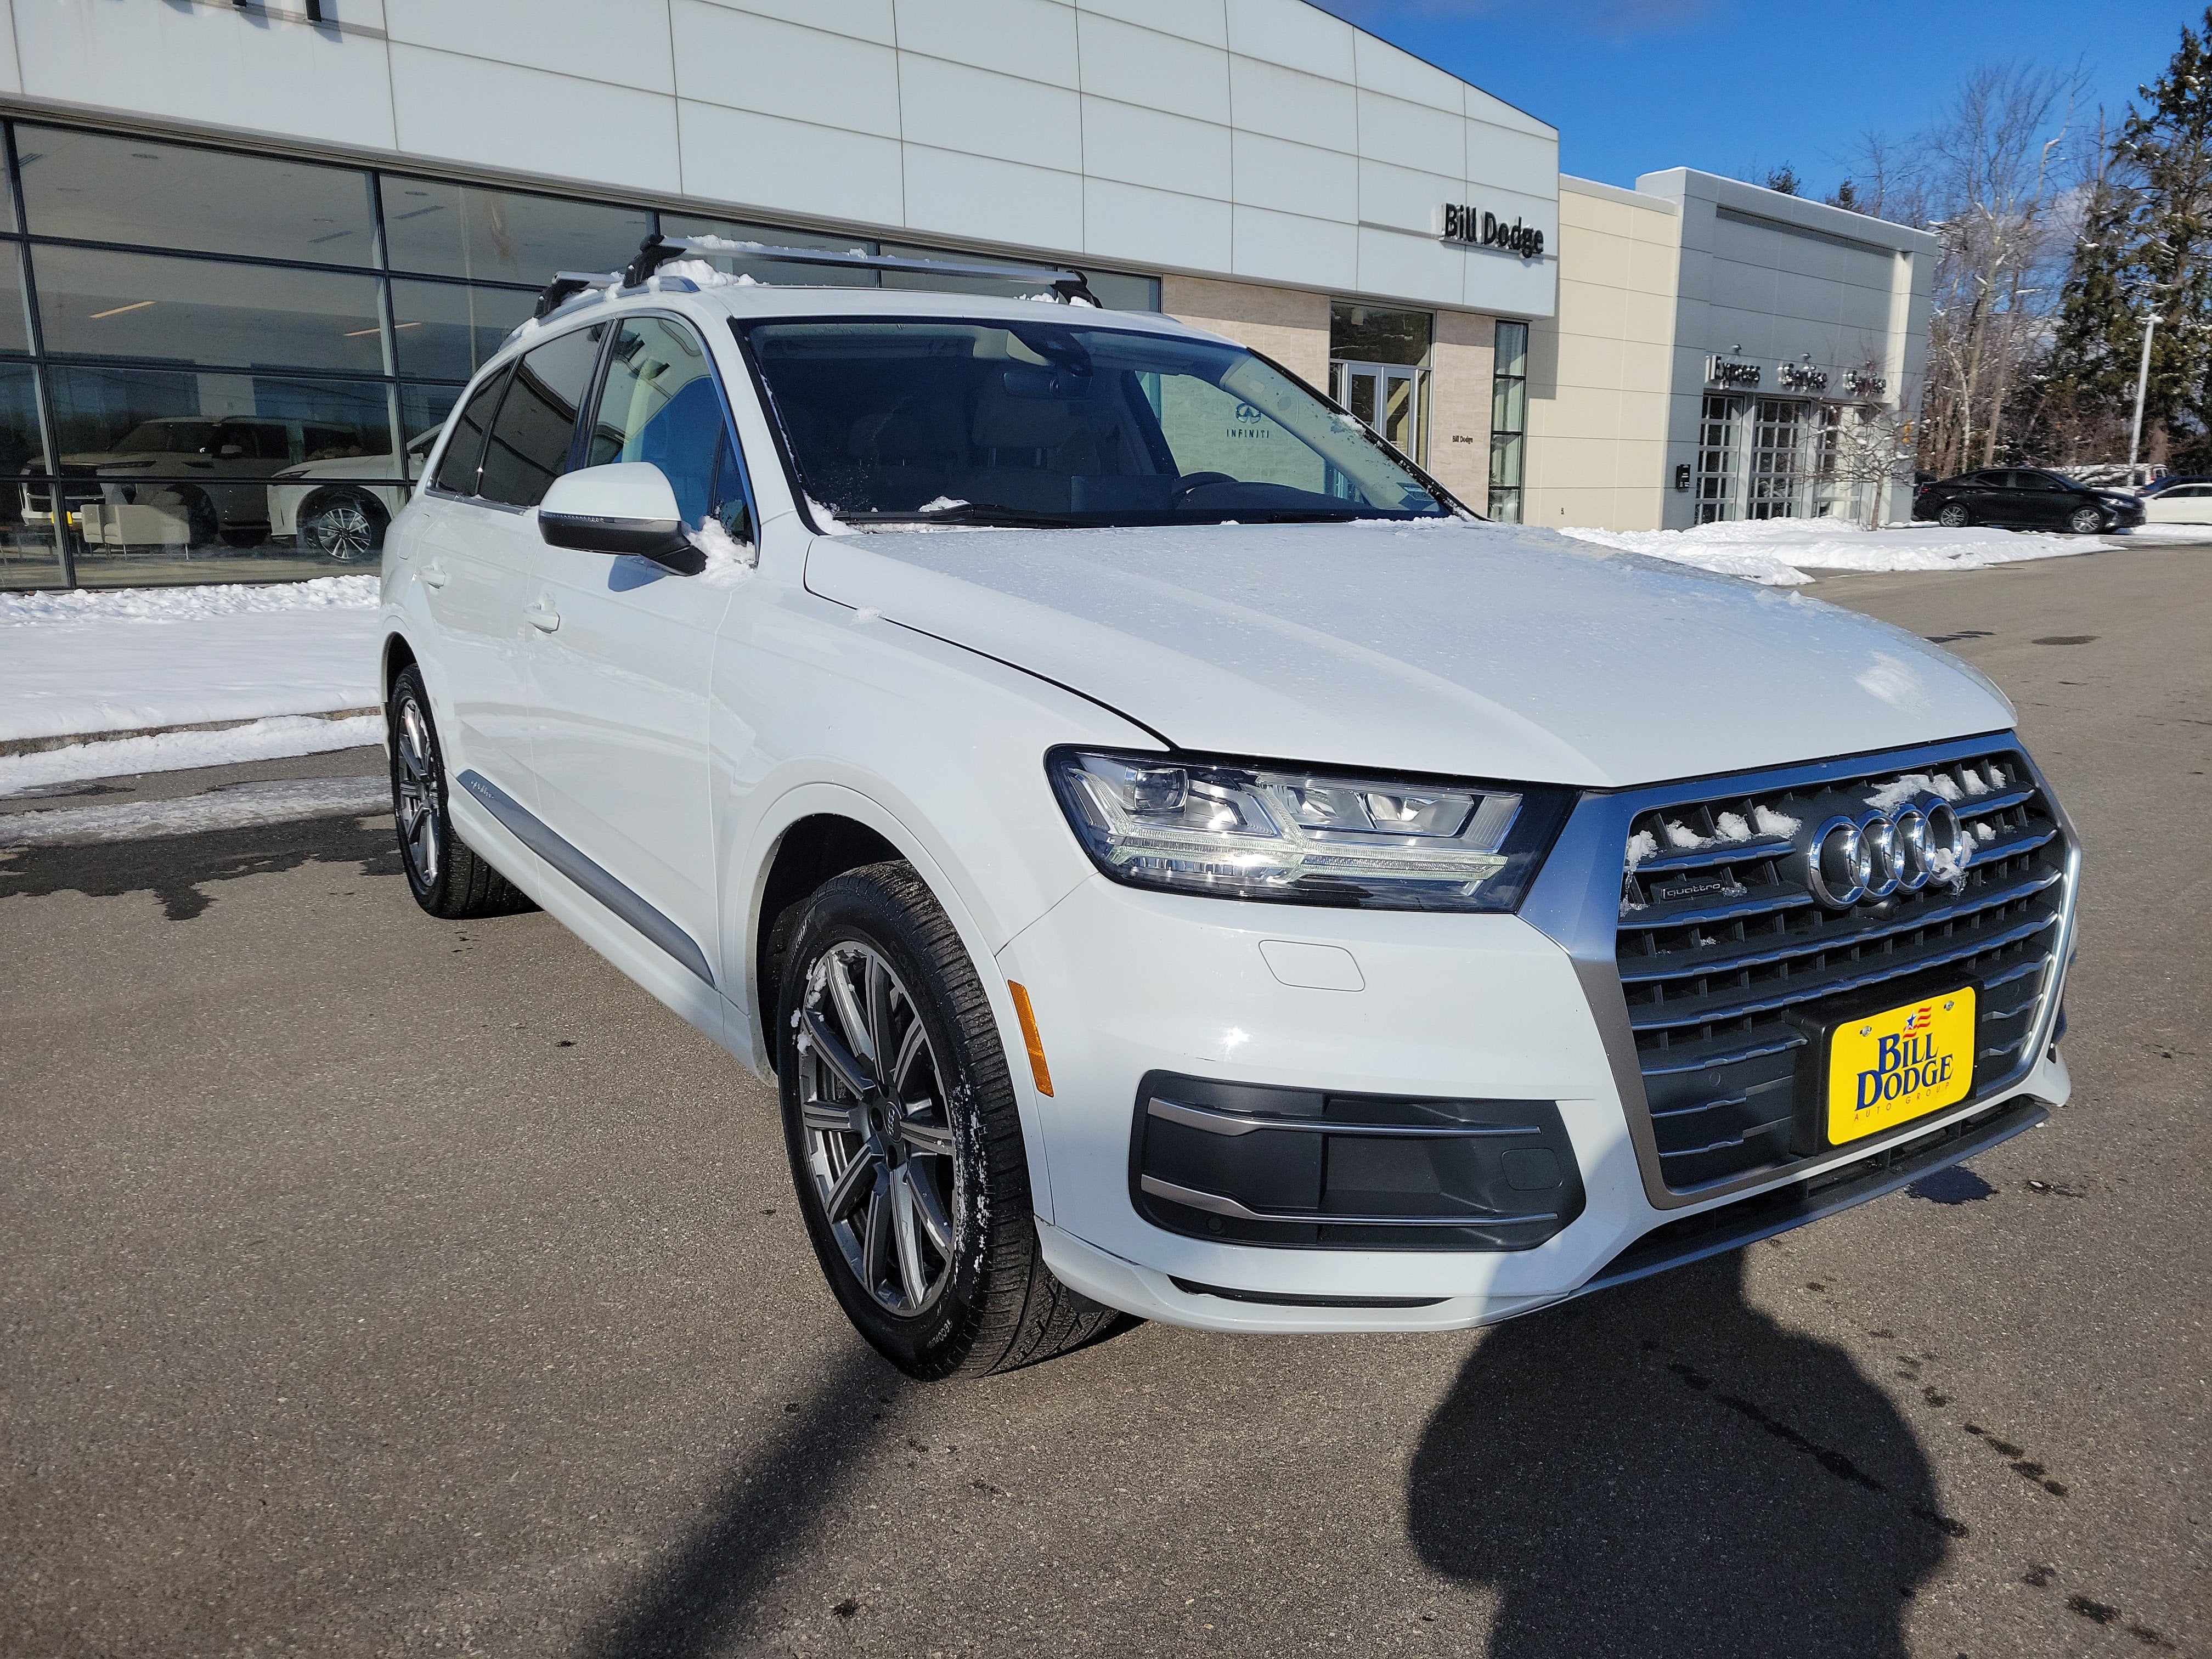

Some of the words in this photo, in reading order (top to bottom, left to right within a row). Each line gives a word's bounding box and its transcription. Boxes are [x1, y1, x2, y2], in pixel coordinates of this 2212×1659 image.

[1445, 203, 1477, 242] Bill
[1484, 211, 1544, 258] Dodge
[1227, 428, 1269, 438] INFINITI
[1667, 883, 1720, 897] quattro
[1877, 1032, 1939, 1075] BILL
[1854, 1054, 1954, 1111] DODGE
[1854, 1103, 1892, 1122] AUTO
[1905, 1081, 1950, 1104] GROUP
